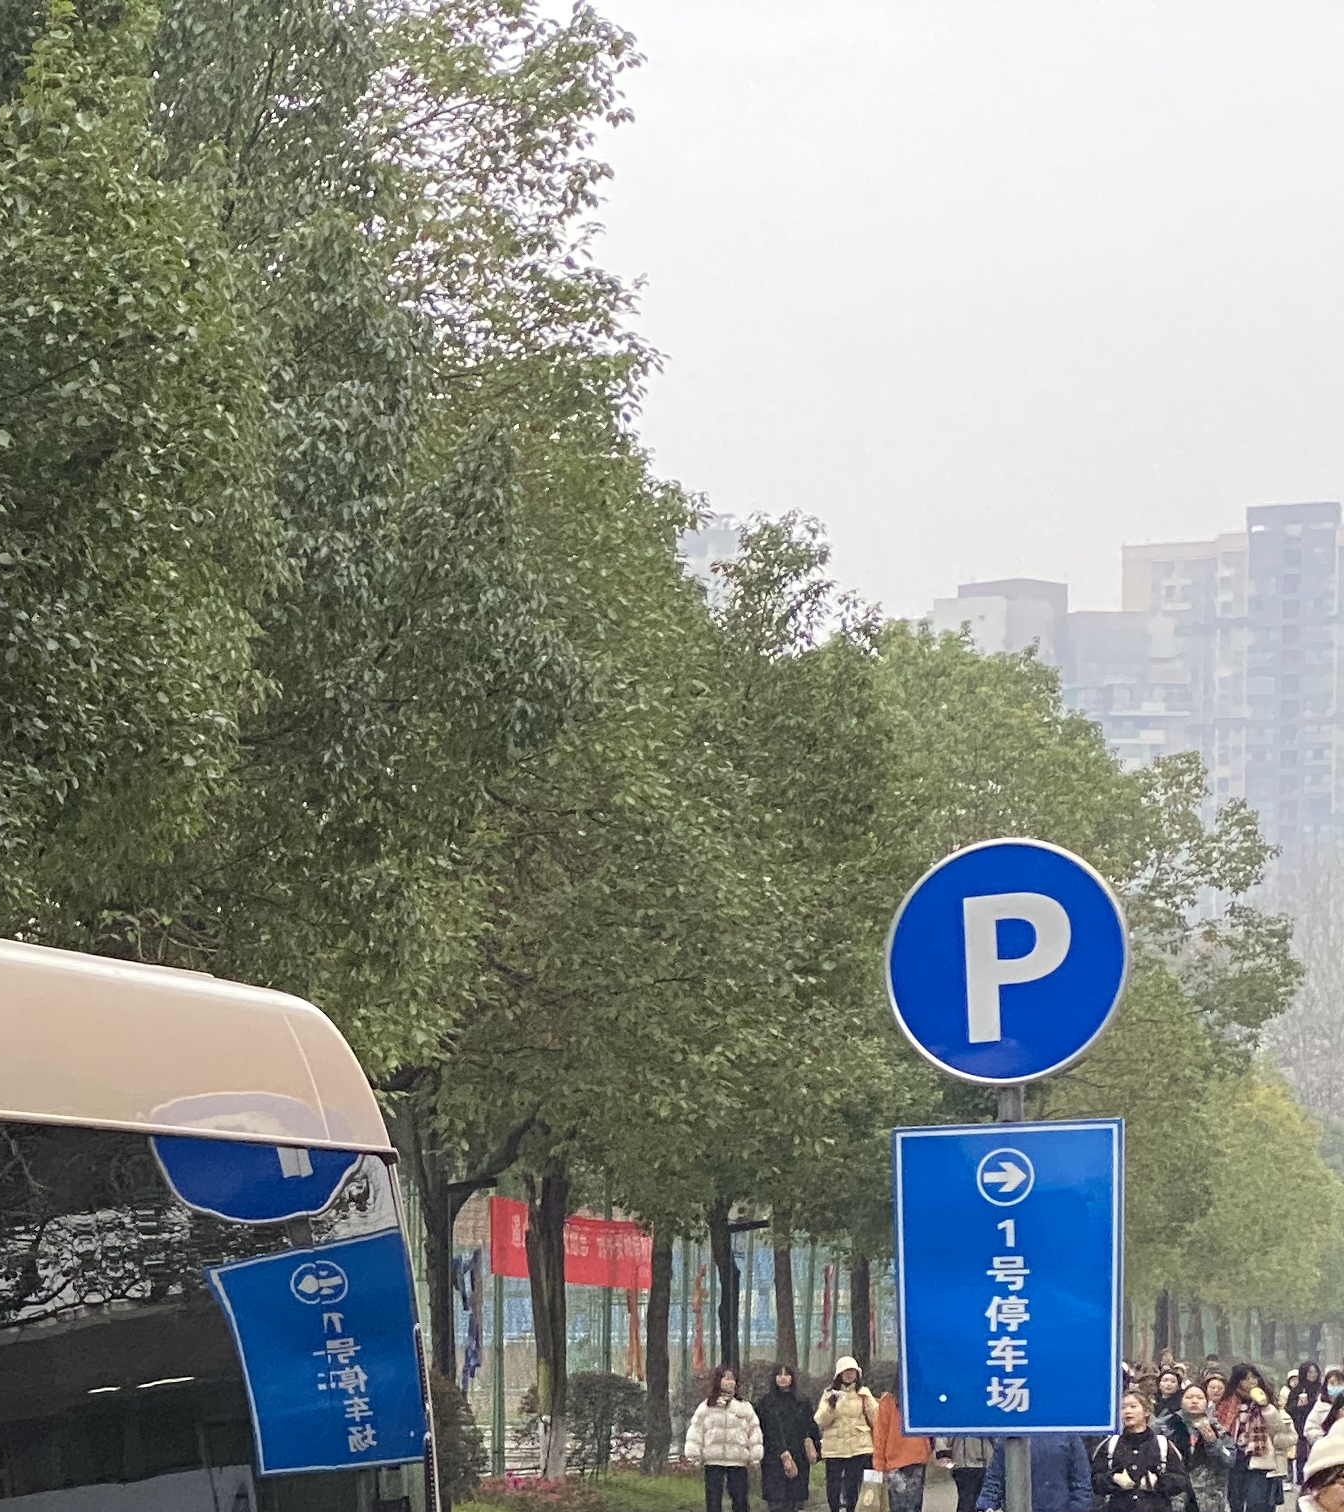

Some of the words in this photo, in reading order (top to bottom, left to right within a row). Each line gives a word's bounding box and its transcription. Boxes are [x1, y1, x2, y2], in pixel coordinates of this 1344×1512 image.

[963, 892, 1072, 1044] P
[985, 1218, 1031, 1413] 1号停车场
